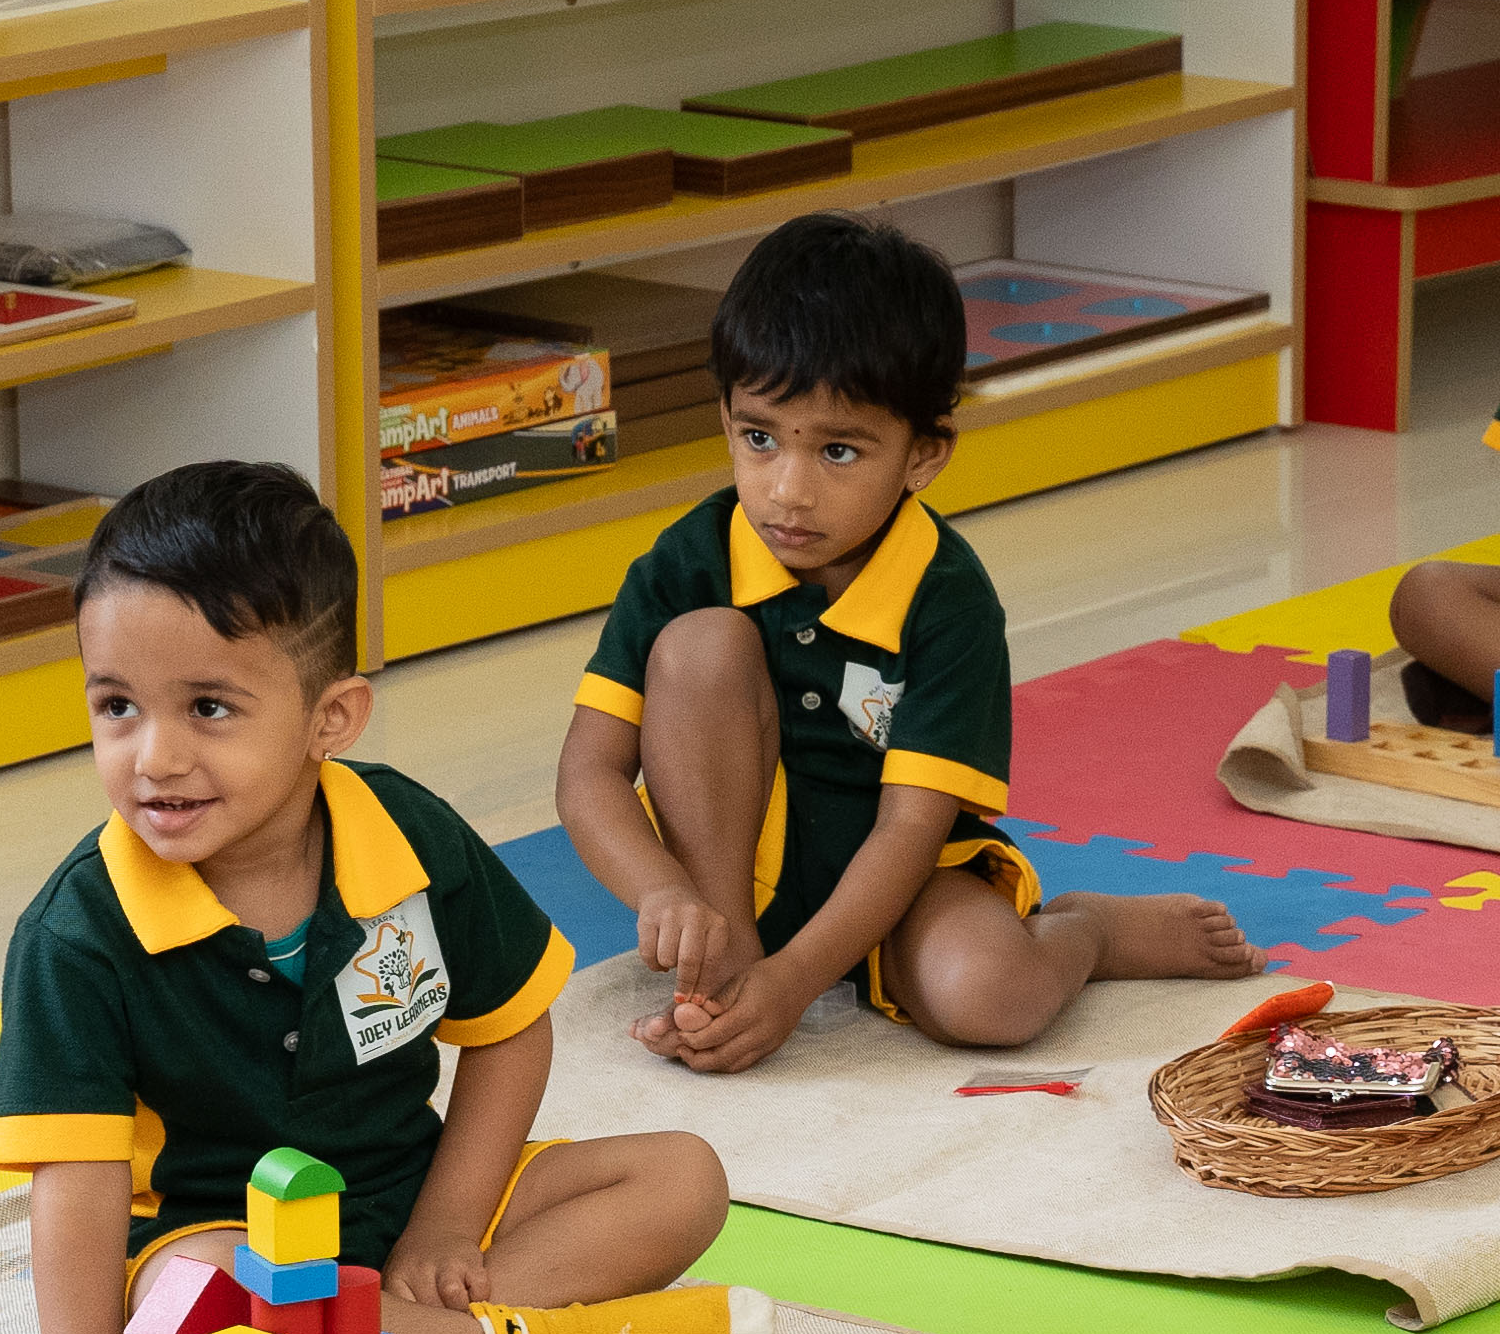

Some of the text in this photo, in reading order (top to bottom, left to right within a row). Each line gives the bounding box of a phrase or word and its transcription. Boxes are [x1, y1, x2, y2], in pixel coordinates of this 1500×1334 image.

[451, 406, 500, 431] ANIMALS
[452, 462, 517, 491] TRANSPORT
[368, 914, 395, 930] LEARN
[356, 1018, 392, 1048] JOEY
[395, 985, 448, 1032] LEARNERS
